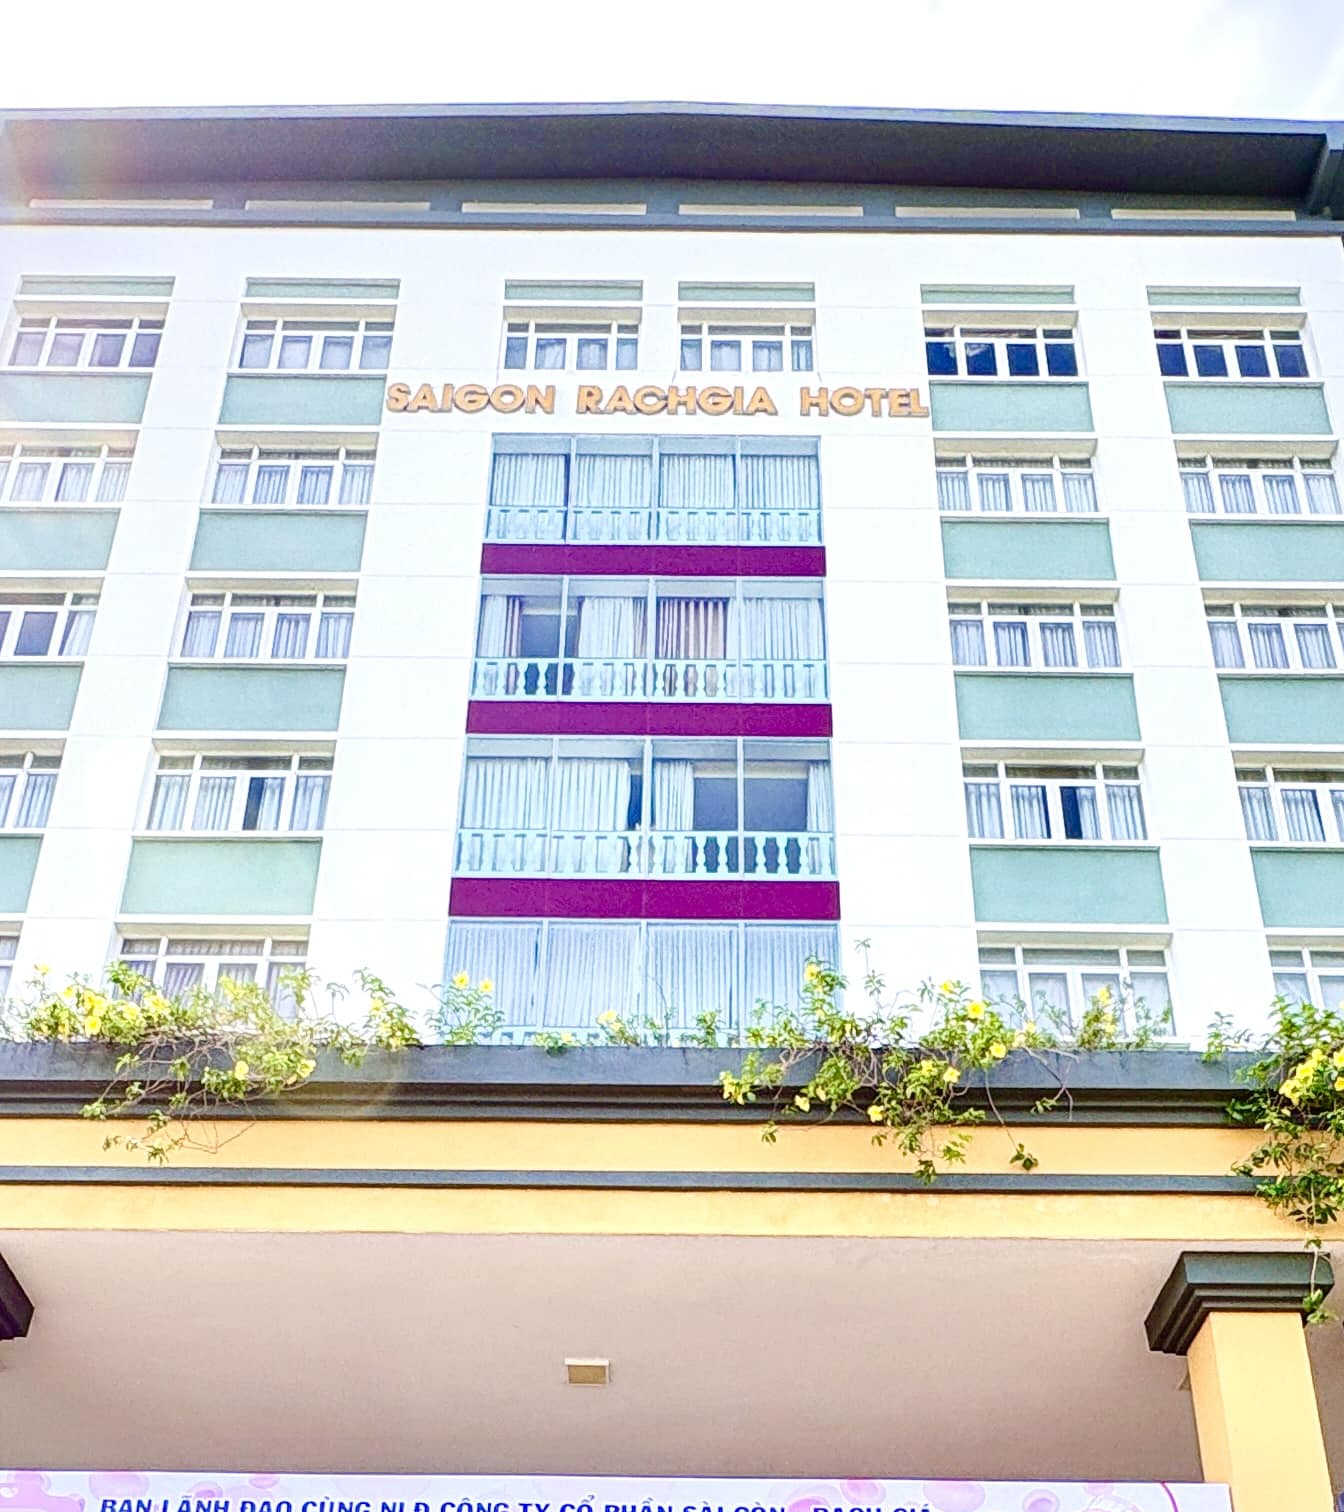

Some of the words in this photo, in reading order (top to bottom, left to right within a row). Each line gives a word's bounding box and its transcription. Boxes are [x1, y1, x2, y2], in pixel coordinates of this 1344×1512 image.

[386, 383, 555, 413] SAIGON
[576, 384, 778, 416] RACHGIA
[799, 386, 930, 418] HOTEL
